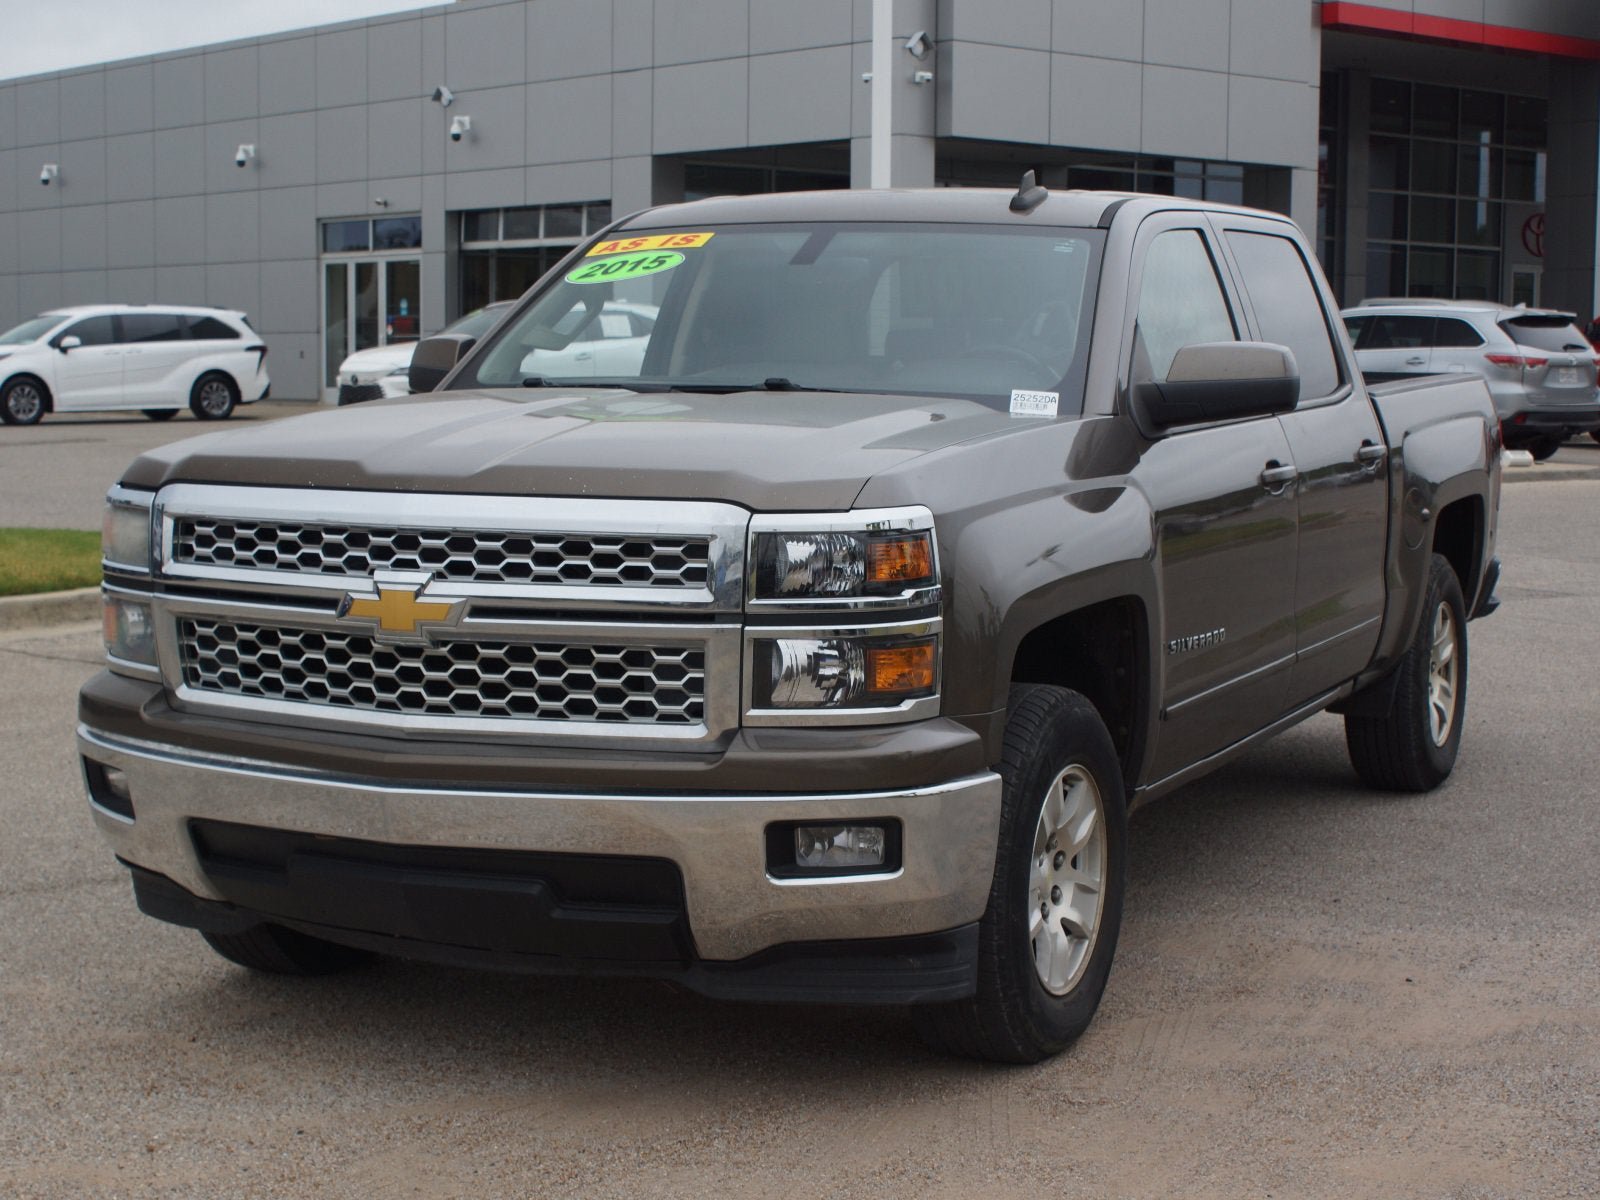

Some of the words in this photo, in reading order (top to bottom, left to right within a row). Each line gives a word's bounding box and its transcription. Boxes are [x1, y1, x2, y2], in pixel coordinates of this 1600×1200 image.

[597, 238, 649, 254] AS
[657, 234, 702, 248] IS
[575, 254, 674, 280] 2015
[1013, 393, 1057, 404] 25252DA
[1168, 627, 1226, 655] SILVERADO
